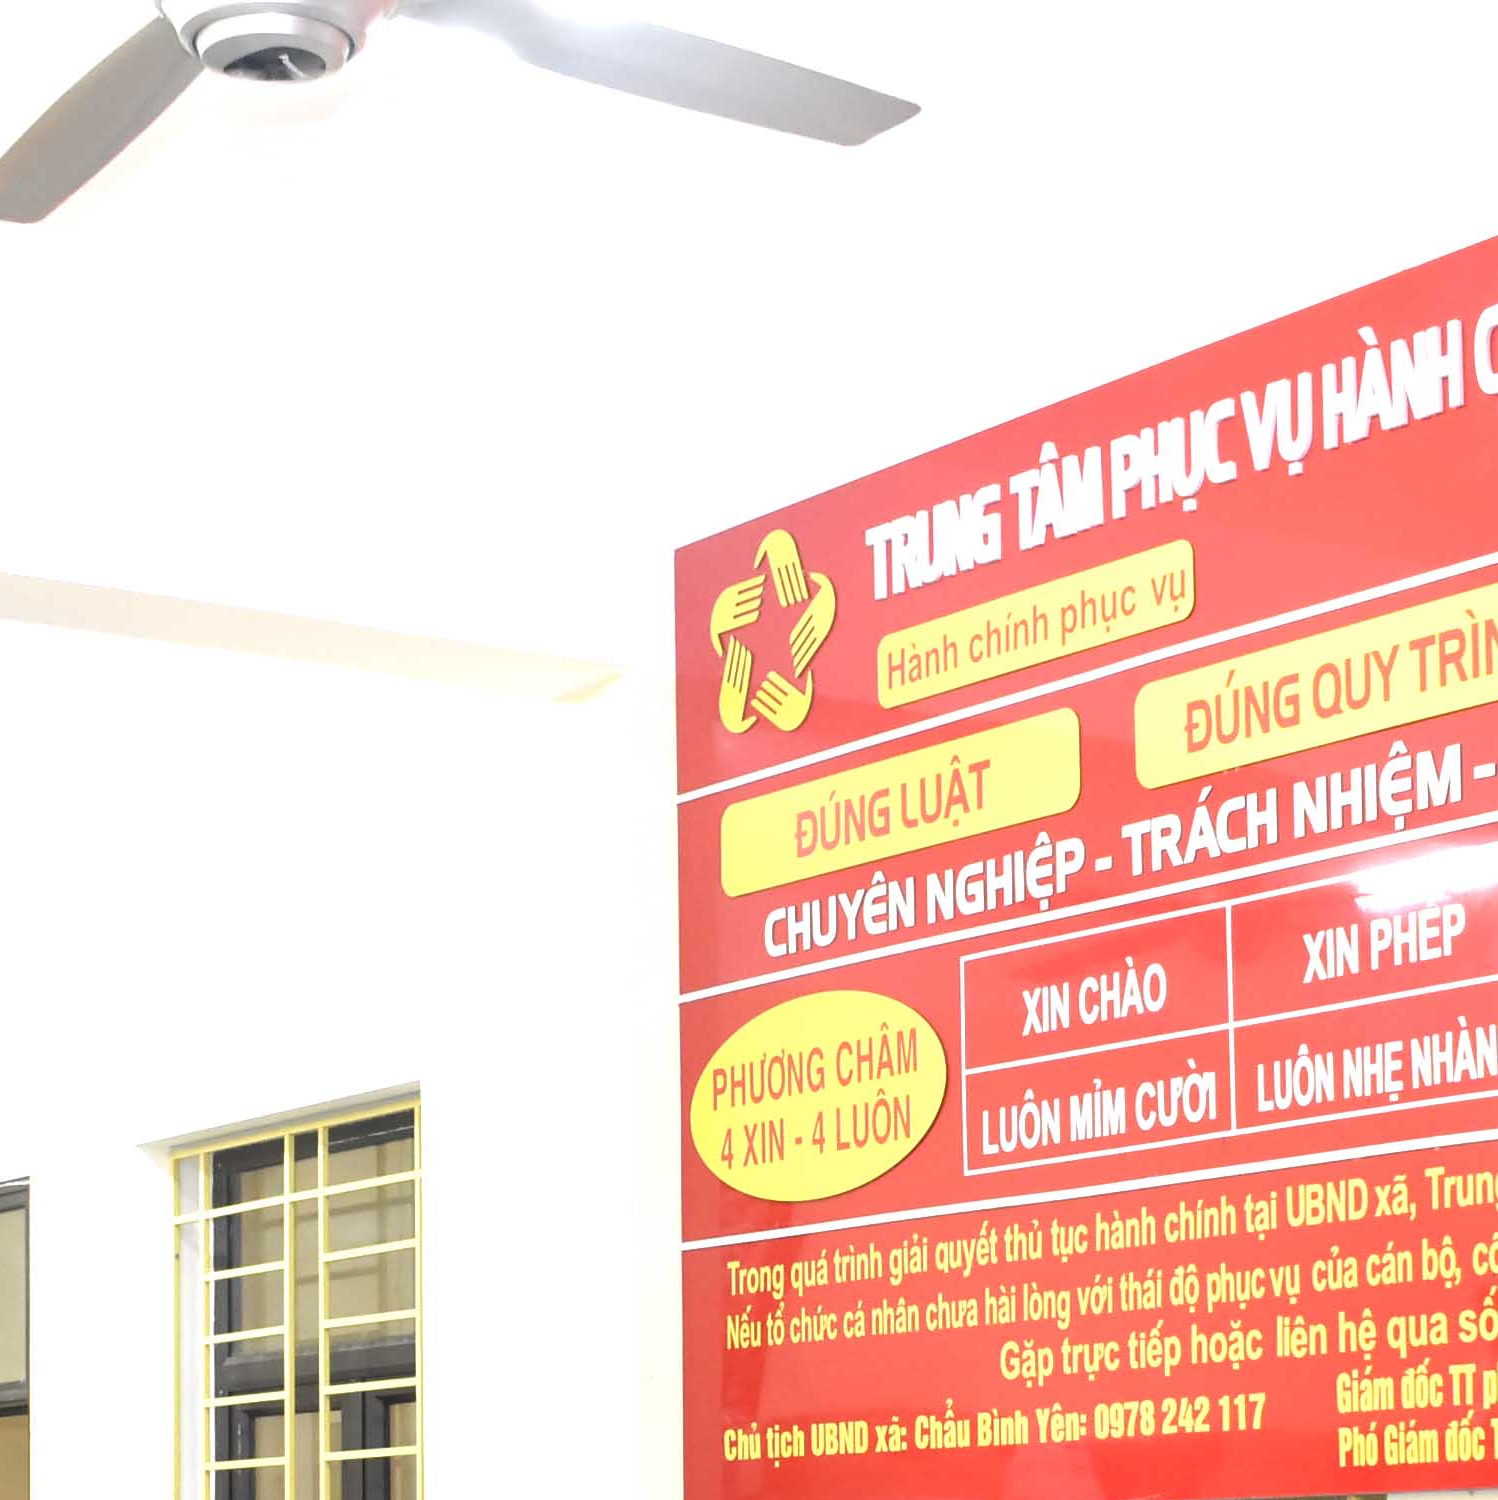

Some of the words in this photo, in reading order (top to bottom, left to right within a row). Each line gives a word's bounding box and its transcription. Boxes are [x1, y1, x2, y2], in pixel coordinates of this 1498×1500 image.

[864, 482, 1003, 602] TRUNG
[1007, 440, 1106, 550] TÂM
[1109, 396, 1239, 522] PHỤC
[1234, 370, 1313, 475] VỤ
[1321, 317, 1467, 452] HÀNH
[886, 633, 959, 691] Hành
[968, 603, 1050, 664] chính
[1059, 584, 1137, 647] phục
[1149, 568, 1187, 613] vụ
[1183, 671, 1302, 755] ĐÚNG
[1311, 643, 1401, 720] QUY
[764, 870, 915, 958] CHUYÊN
[926, 830, 1085, 924] NGHIỆP
[1121, 785, 1278, 877] TRÁCH
[1292, 739, 1462, 839] NHIỆM
[793, 786, 892, 859] ĐÚNG
[899, 753, 992, 830] LUẬT
[1021, 981, 1071, 1037] XIN
[1077, 955, 1168, 1026] CHÀO
[711, 1045, 827, 1113] PHƯƠNG
[834, 1020, 919, 1088] CHÂM
[981, 1087, 1062, 1156] LUÔN
[1068, 1077, 1127, 1143] MỈM
[1134, 1057, 1218, 1132] CƯỜI
[1256, 1042, 1336, 1114] LUÔN
[1341, 1039, 1405, 1103] NHẸ
[725, 1259, 786, 1302] Trong
[789, 1247, 830, 1298] quá
[832, 1241, 884, 1285] trình
[887, 1231, 930, 1288] giải
[933, 1218, 1000, 1279] quyết
[1002, 1217, 1044, 1264] thủ
[1048, 1216, 1090, 1265] tục
[1094, 1204, 1158, 1253] hành
[1162, 1193, 1238, 1245] chính
[1242, 1189, 1279, 1242] tại
[1284, 1176, 1370, 1229] UBND
[1373, 1172, 1418, 1222] xã,
[998, 1337, 1056, 1390] Gặp
[1059, 1336, 1122, 1383] trực
[1126, 1318, 1183, 1378] tiếp
[1189, 1318, 1265, 1372] hoặc
[1275, 1313, 1329, 1360] liên
[1337, 1306, 1378, 1362] hệ
[1385, 1310, 1450, 1361] qua
[1334, 1363, 1396, 1415] Giám
[1399, 1356, 1445, 1411] đốc
[1447, 1361, 1478, 1408] TT
[722, 1421, 763, 1463] Chủ
[765, 1423, 806, 1469] tịch
[809, 1419, 870, 1458] UBND
[873, 1414, 909, 1454] xã:
[913, 1396, 972, 1451] Chẩu
[976, 1406, 1031, 1448] Bình
[1033, 1400, 1089, 1445] Yên:
[1092, 1398, 1157, 1441] 0978
[1159, 1394, 1212, 1436] 242
[1216, 1390, 1267, 1433] 117
[1336, 1420, 1380, 1469] Phó
[1382, 1417, 1441, 1467] Giám
[1443, 1407, 1487, 1463] đốc
